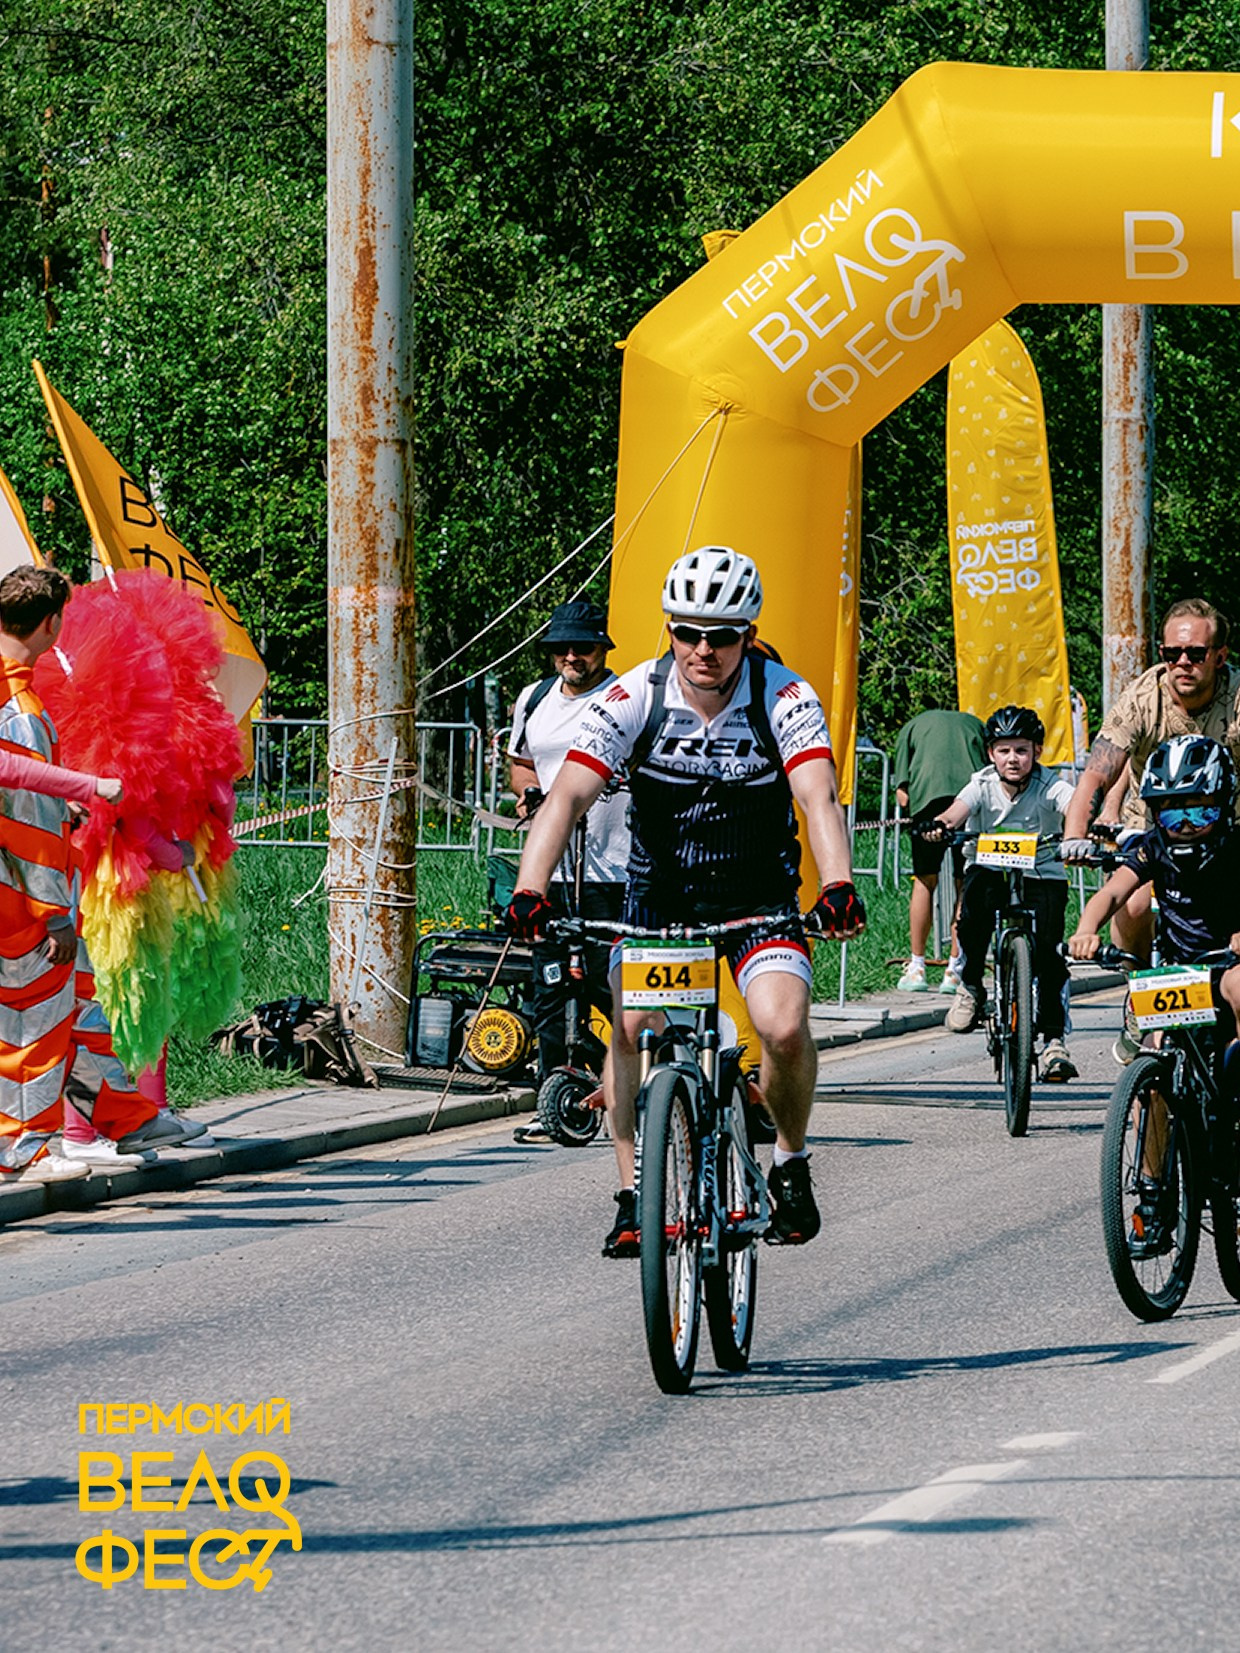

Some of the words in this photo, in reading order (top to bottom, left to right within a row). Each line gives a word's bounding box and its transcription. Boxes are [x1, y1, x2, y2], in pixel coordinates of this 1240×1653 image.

[721, 168, 884, 320] ПЕРМСКИЙ
[1123, 210, 1189, 280] В
[993, 841, 1020, 853] 133
[645, 965, 692, 989] 614
[1153, 988, 1192, 1013] 621
